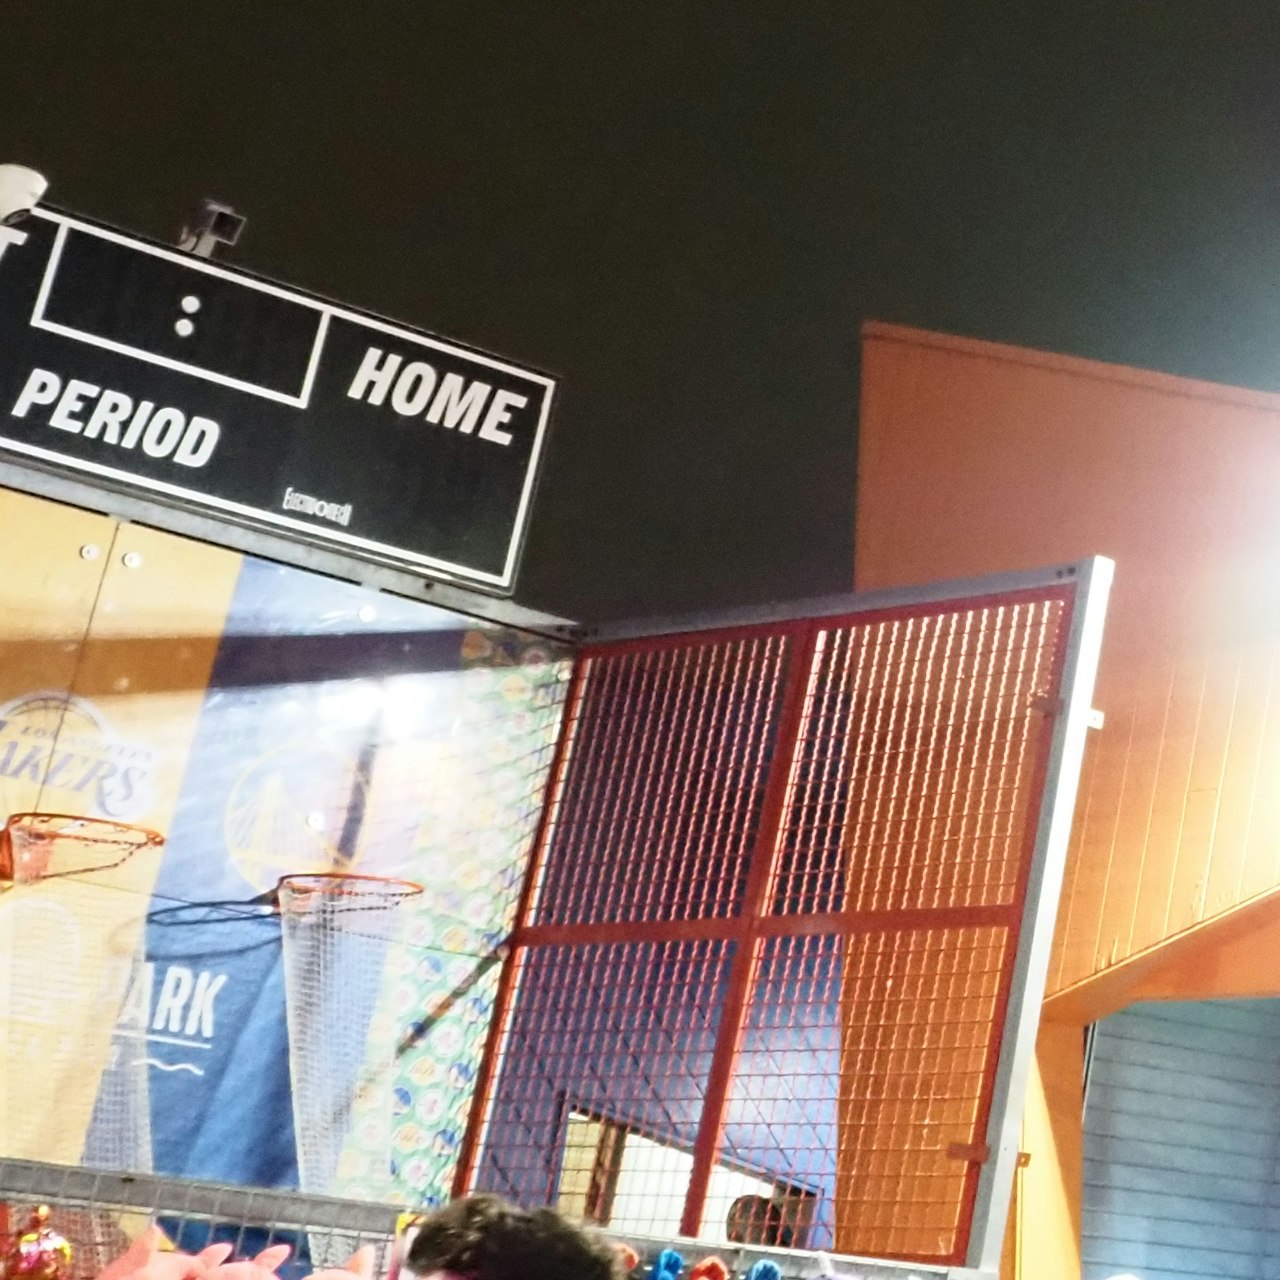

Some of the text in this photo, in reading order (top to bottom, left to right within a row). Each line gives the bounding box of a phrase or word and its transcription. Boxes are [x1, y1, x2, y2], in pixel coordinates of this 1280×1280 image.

[11, 368, 220, 469] PERIOD
[347, 347, 528, 446] HOME
[0, 740, 147, 817] AKERS
